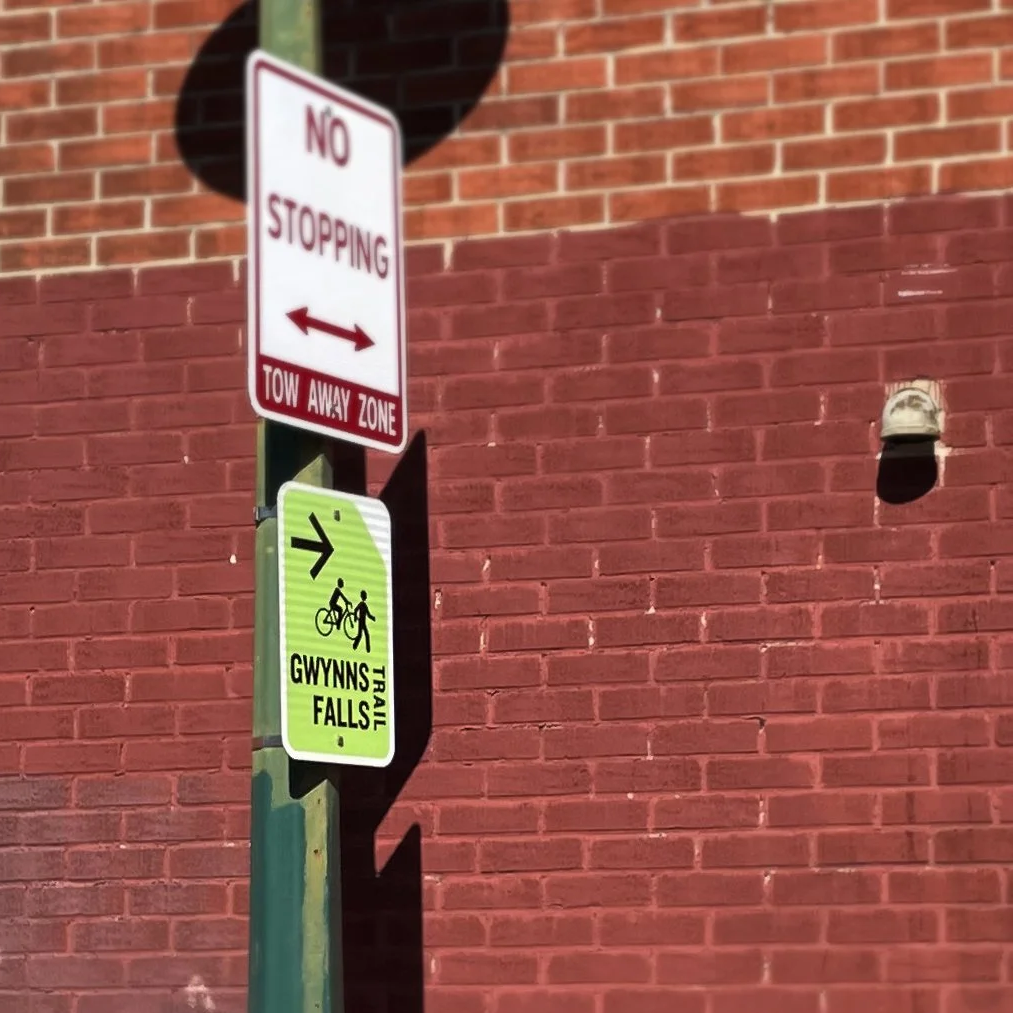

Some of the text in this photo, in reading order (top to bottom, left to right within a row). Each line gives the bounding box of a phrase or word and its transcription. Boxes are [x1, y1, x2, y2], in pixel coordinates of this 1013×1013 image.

[305, 104, 350, 167] NO
[267, 192, 389, 280] STOPPING
[262, 364, 397, 437] TOW AWAY ZONE
[290, 653, 369, 692] GWYNNS
[373, 666, 386, 731] TRAIL
[313, 695, 370, 730] FALLS
